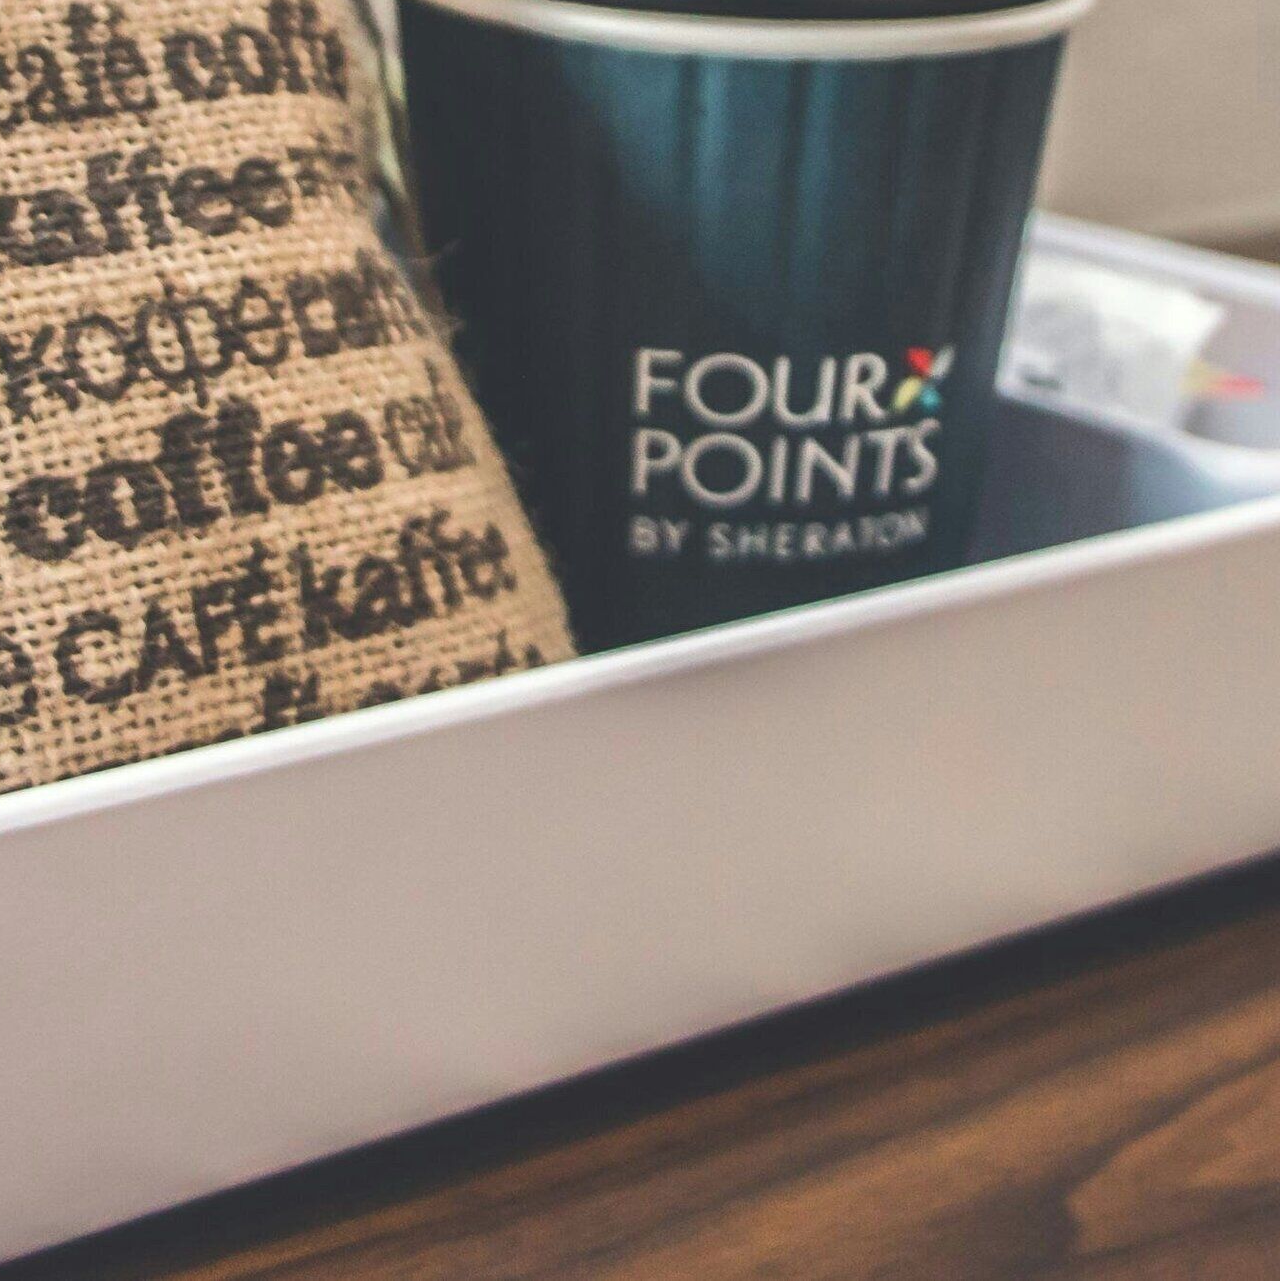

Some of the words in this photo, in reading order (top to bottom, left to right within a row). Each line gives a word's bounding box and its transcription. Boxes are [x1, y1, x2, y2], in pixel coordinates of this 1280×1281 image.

[634, 346, 887, 428] FOUR
[3, 395, 385, 564] coffee
[630, 417, 942, 508] POINTS
[629, 515, 688, 555] BY
[53, 537, 286, 704] CAFÉ
